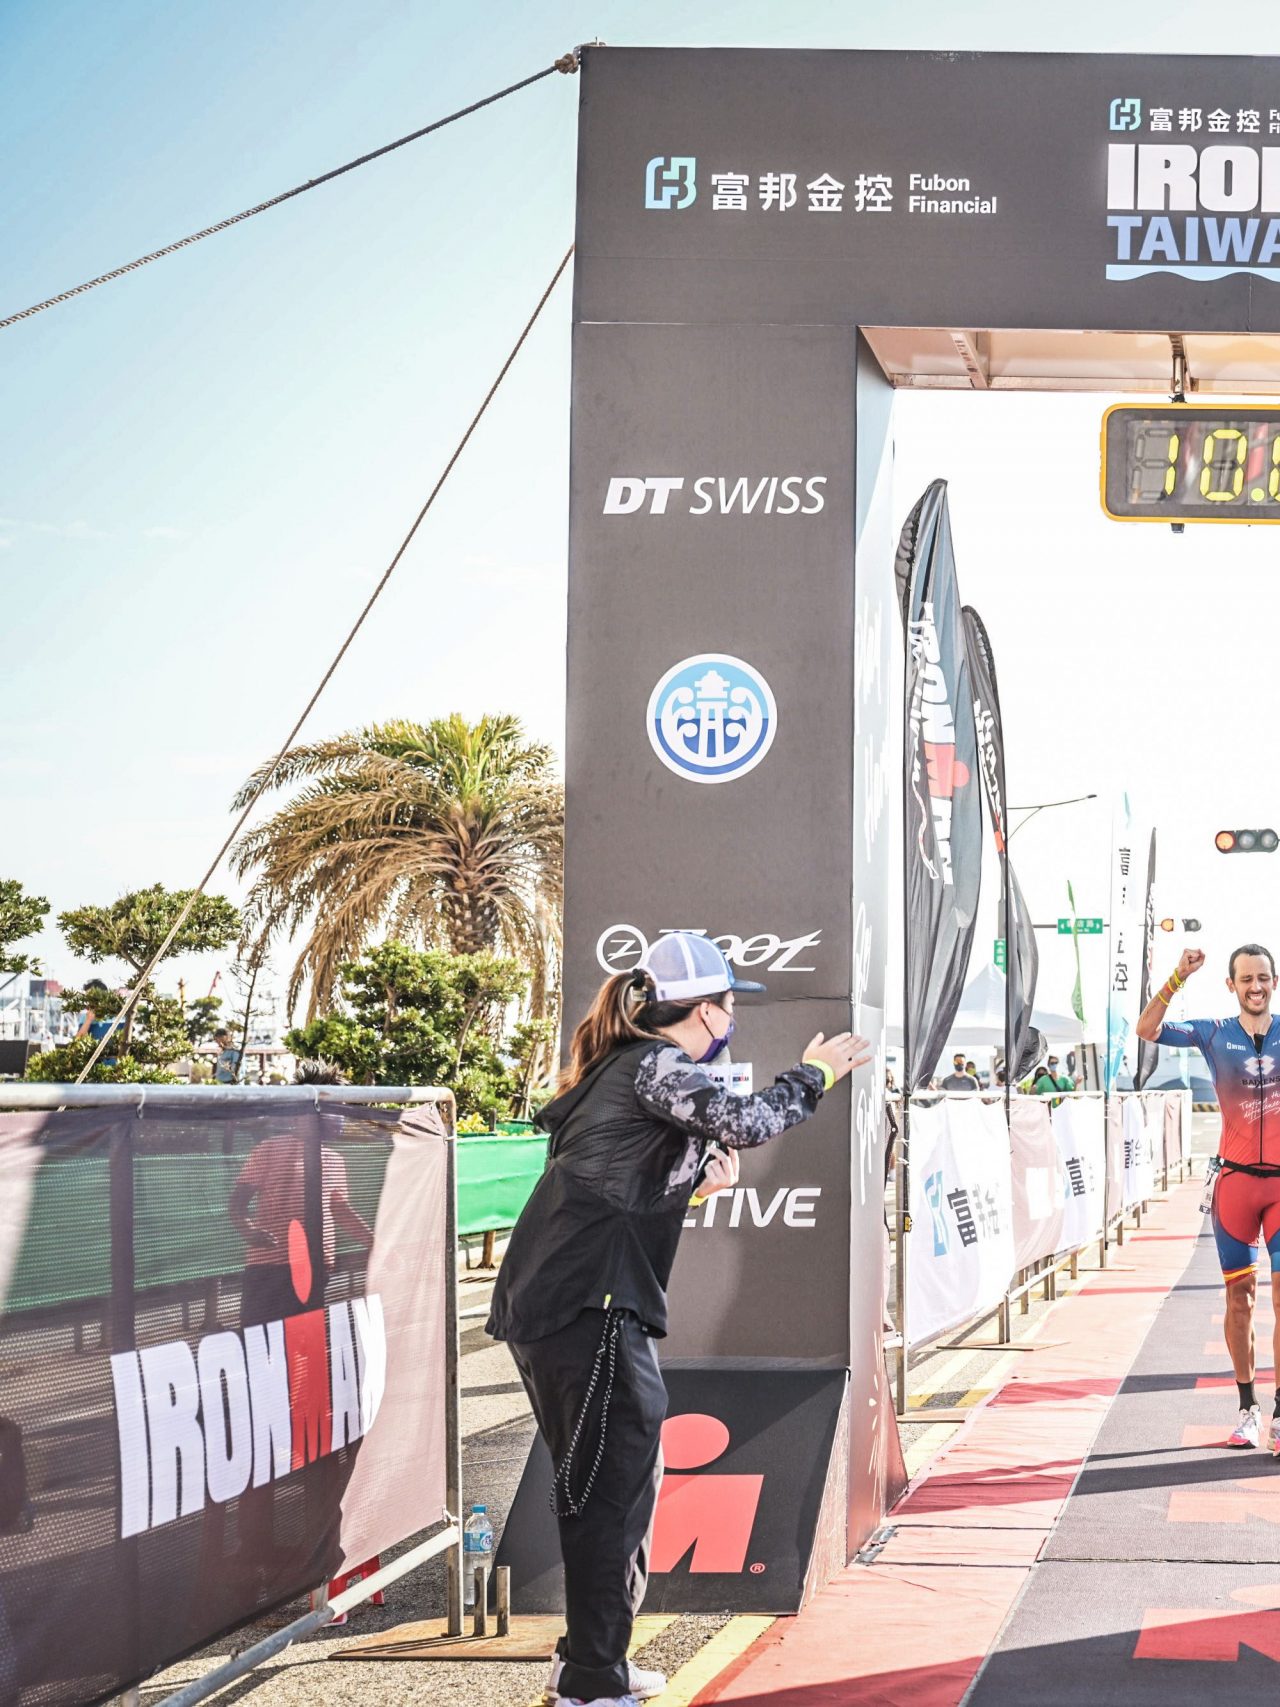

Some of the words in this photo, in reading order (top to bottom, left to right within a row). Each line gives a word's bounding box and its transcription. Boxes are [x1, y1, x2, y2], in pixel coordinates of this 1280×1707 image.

[1149, 107, 1261, 134] 富邦金控
[711, 171, 894, 213] 富邦金控
[909, 173, 970, 192] Fubon
[908, 195, 997, 214] Financial
[602, 477, 685, 515] DT
[688, 476, 828, 515] SWISS
[682, 1187, 822, 1228] TIVE
